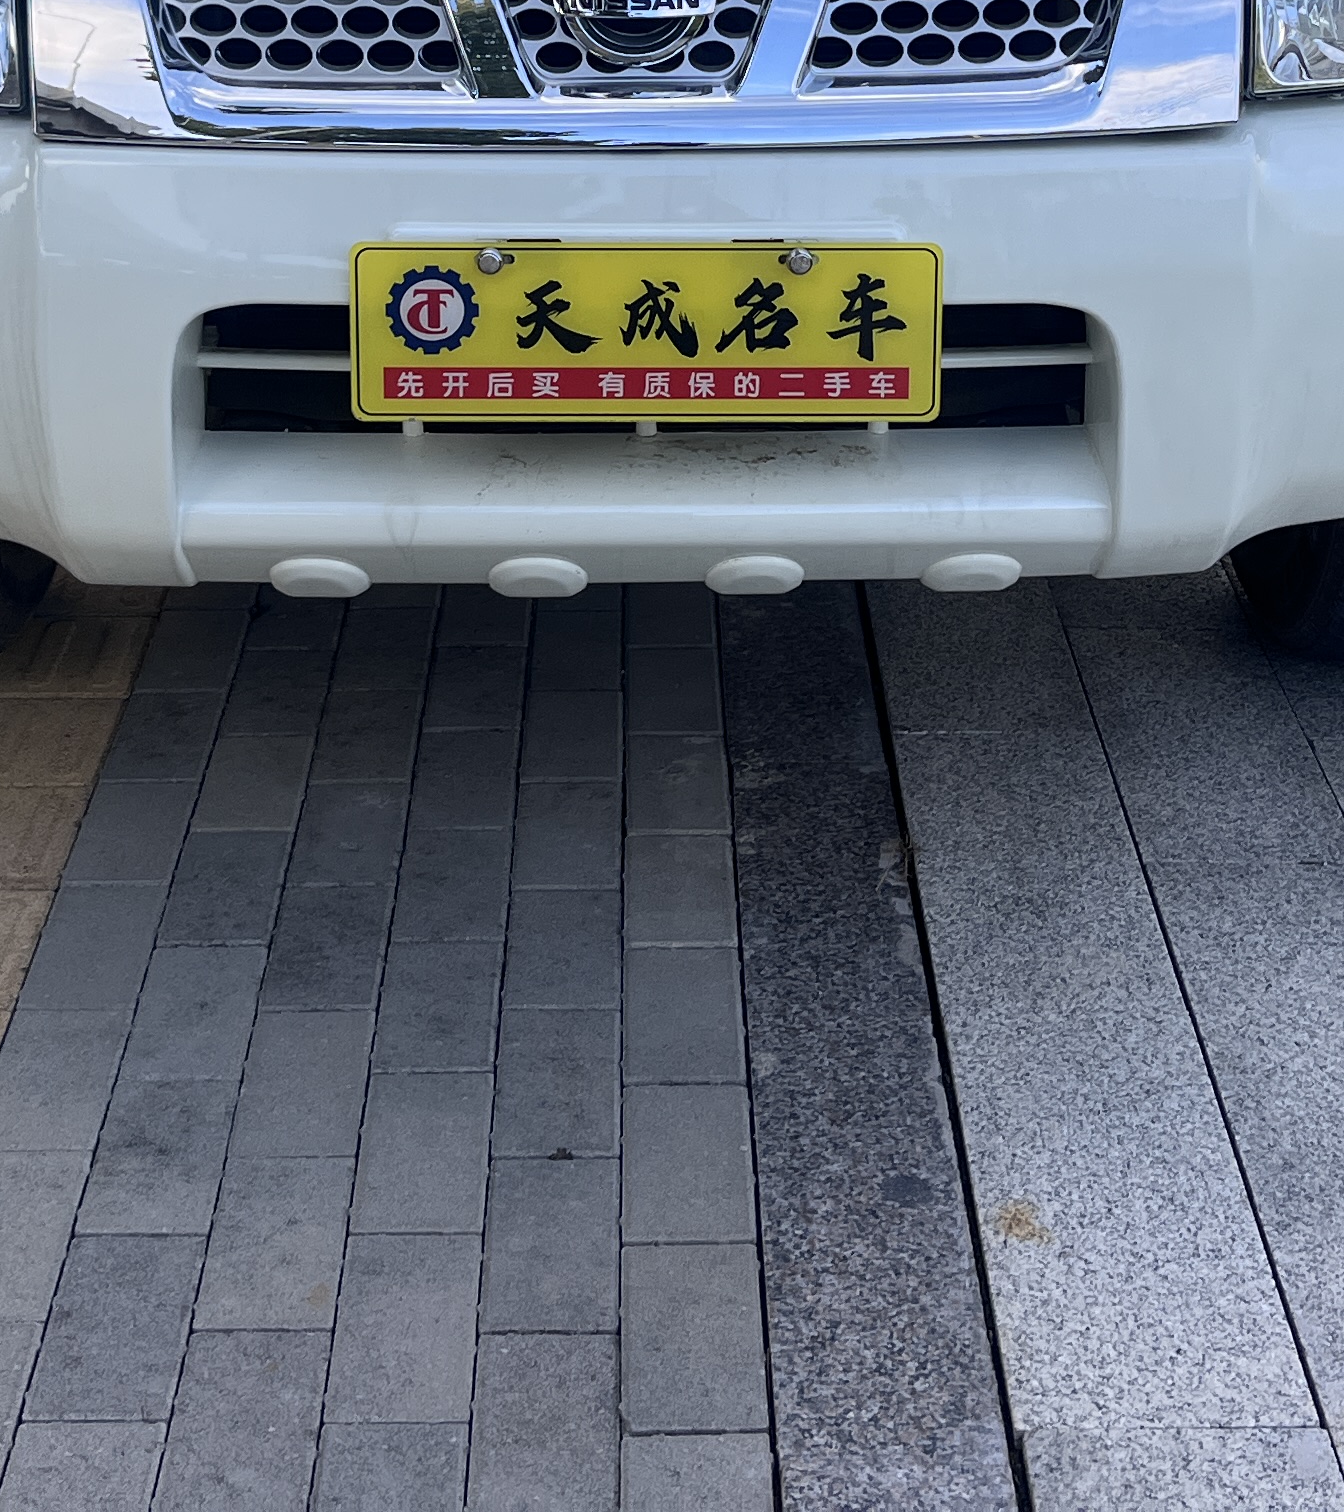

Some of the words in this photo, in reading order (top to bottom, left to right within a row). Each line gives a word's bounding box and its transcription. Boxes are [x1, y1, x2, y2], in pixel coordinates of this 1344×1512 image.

[515, 272, 907, 362] 天成名车
[396, 371, 561, 398] 先开后买
[597, 371, 897, 399] 有质保的二手车
